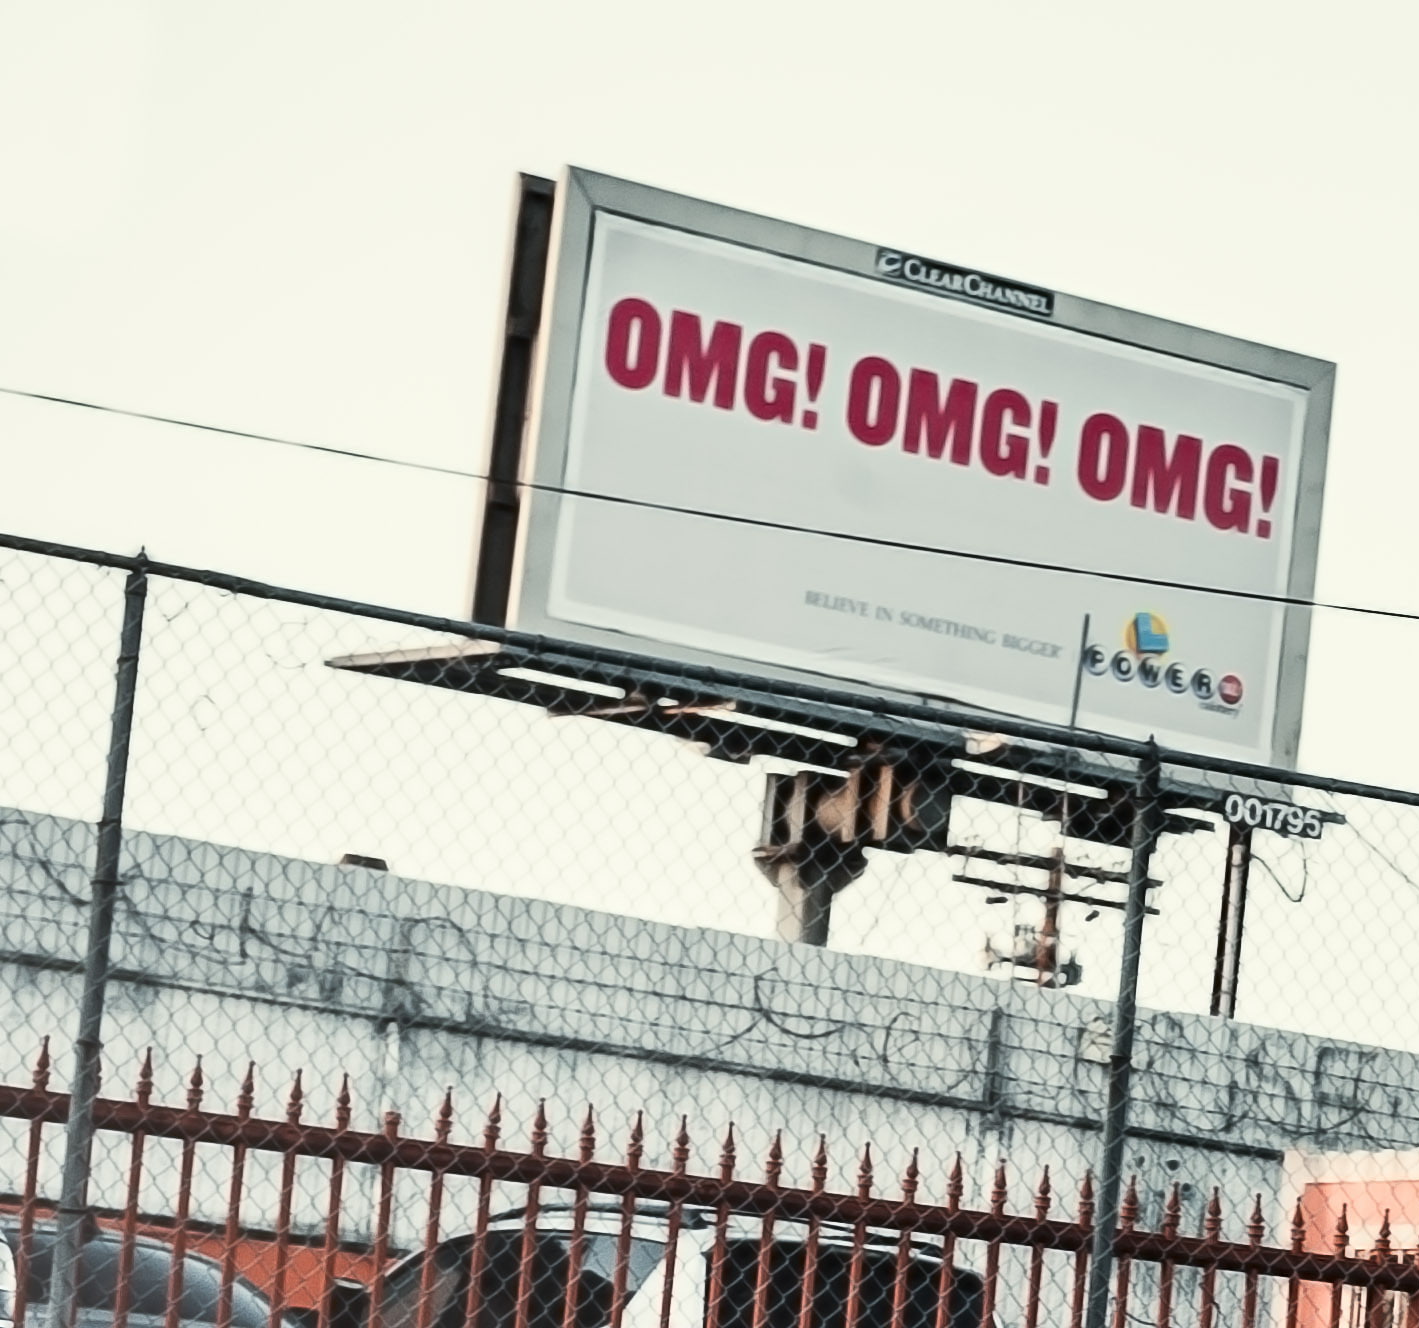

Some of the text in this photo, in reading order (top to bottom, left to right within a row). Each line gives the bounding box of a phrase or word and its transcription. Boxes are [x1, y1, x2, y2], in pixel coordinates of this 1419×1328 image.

[605, 298, 1280, 540] OMG! OMG! OMG!
[804, 590, 1064, 660] BELIEVE IN SOMETHING BIGGER
[1225, 794, 1320, 838] 001795
